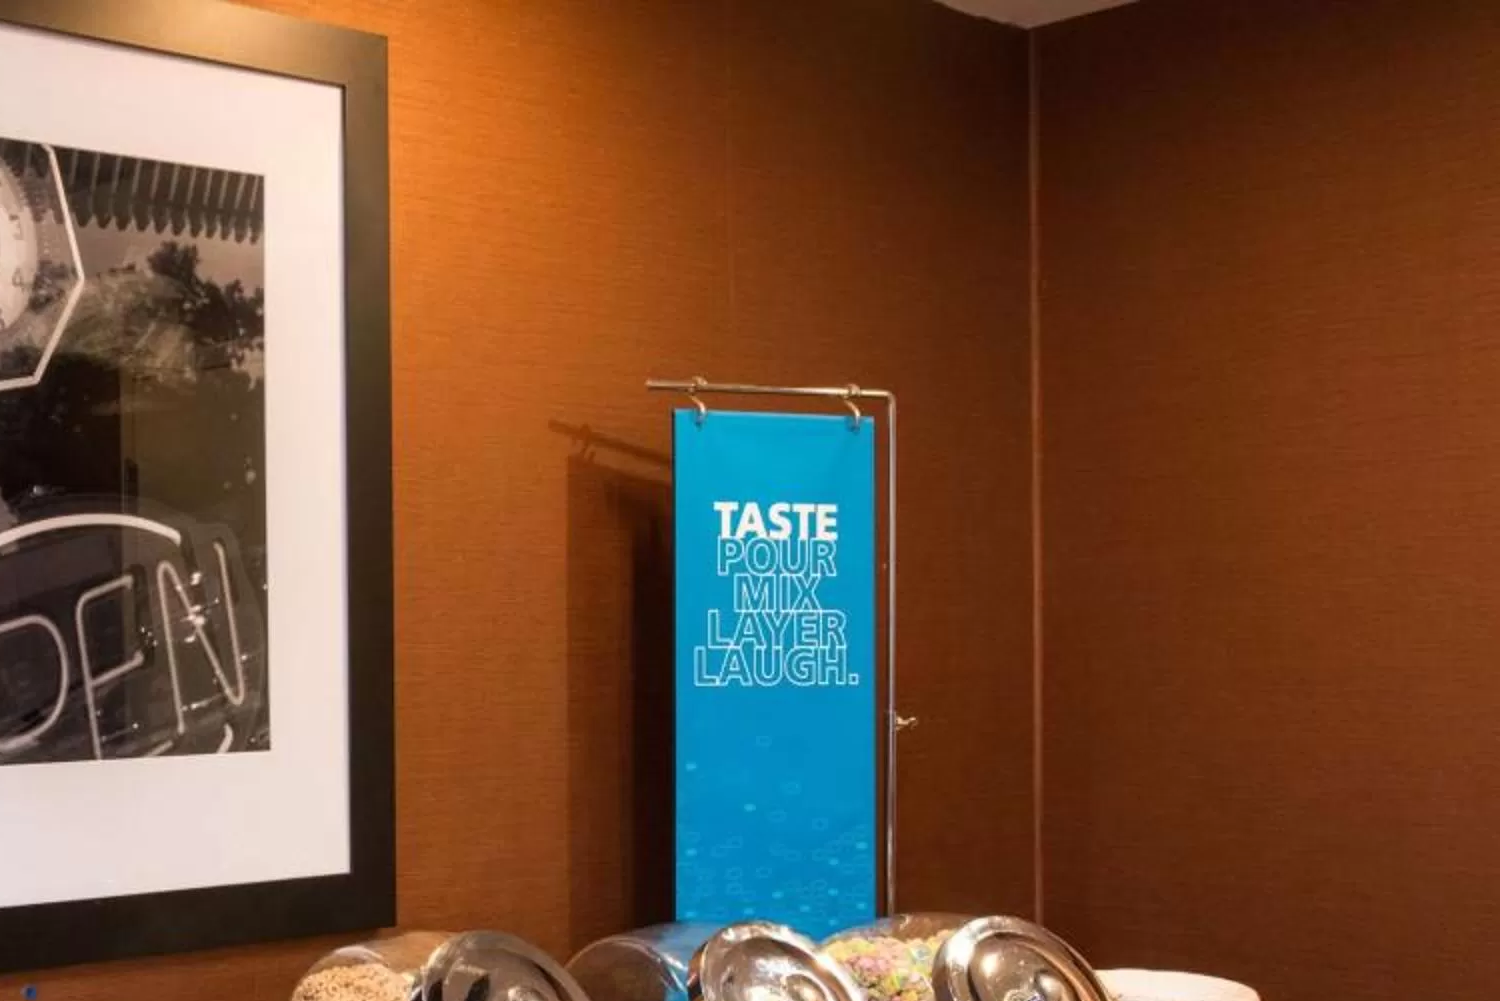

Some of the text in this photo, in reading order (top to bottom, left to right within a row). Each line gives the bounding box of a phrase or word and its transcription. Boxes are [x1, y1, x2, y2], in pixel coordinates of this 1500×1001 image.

[713, 501, 838, 540] TASTE
[716, 536, 838, 577] POUR
[733, 573, 822, 613] MIX
[707, 609, 848, 649] LAYER
[693, 645, 860, 687] LAUGH.
